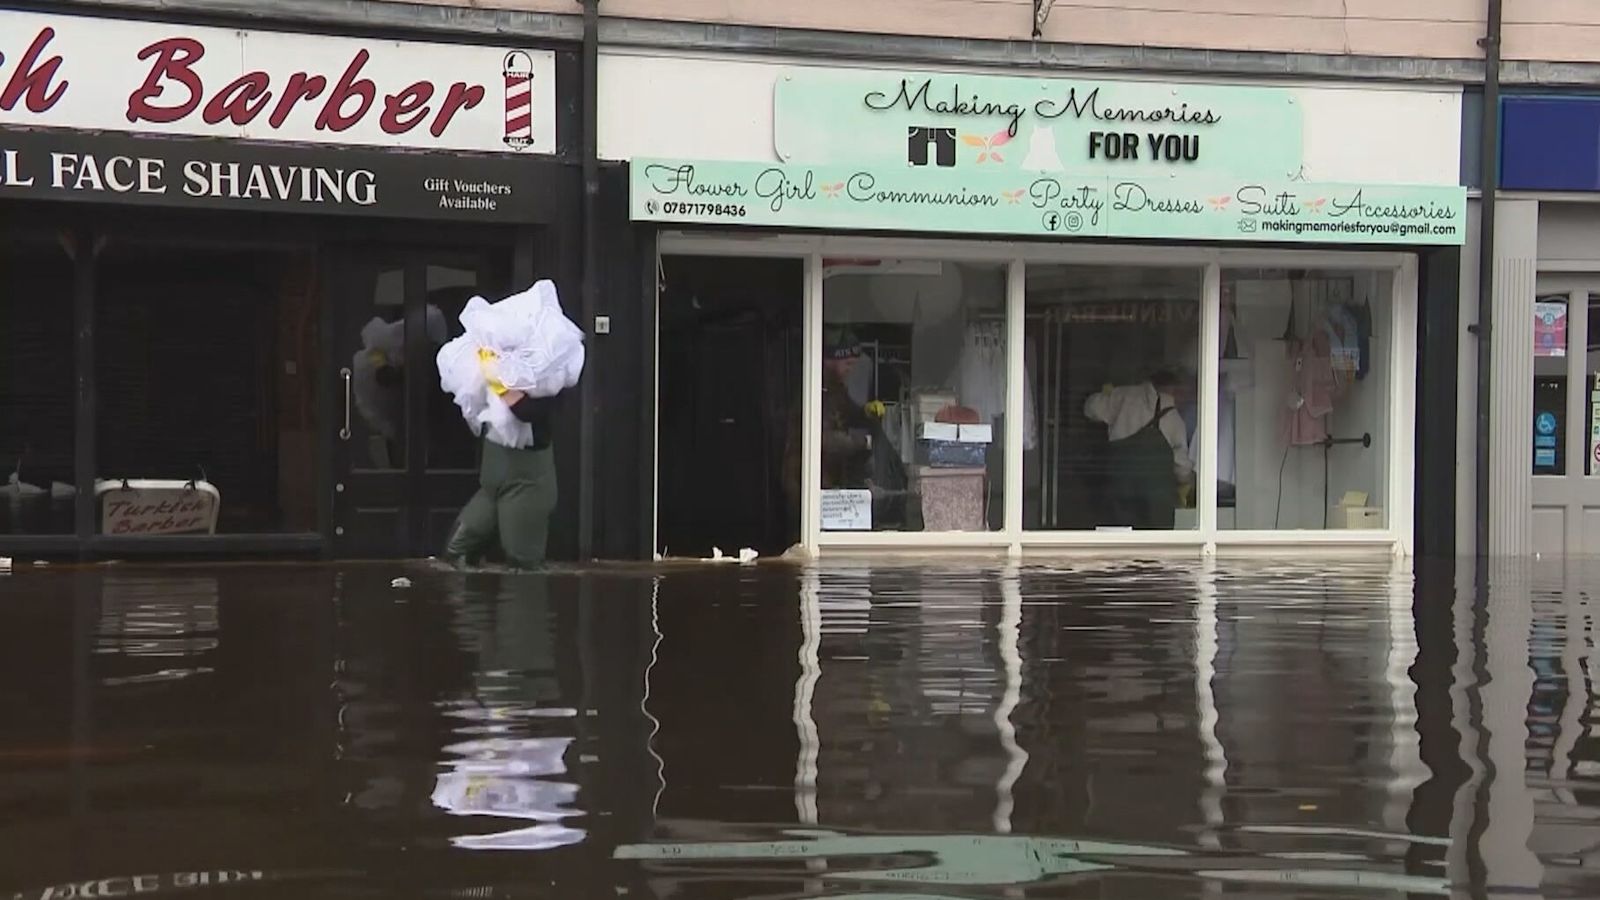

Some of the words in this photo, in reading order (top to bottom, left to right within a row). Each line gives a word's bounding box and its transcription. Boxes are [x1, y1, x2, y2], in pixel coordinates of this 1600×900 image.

[0, 27, 69, 114] h
[128, 37, 485, 138] Barber
[864, 79, 1026, 136] Making
[1034, 87, 1221, 125] Memories
[1089, 132, 1140, 160] FOR
[1147, 134, 1200, 162] YOU
[0, 150, 35, 187] L
[50, 152, 167, 194] FACE
[182, 161, 378, 205] SHAVING
[424, 178, 450, 193] Gift
[453, 180, 512, 196] Vouchers
[439, 194, 498, 211] Available
[645, 164, 748, 195] Flower
[755, 168, 816, 212] Girl
[846, 172, 999, 207] Communion
[1029, 178, 1104, 226] Party
[1113, 182, 1204, 214] Dresses
[1236, 185, 1300, 216] Suits
[1327, 188, 1456, 219] Accessories
[663, 201, 746, 217] 07871798436
[1261, 219, 1456, 237] makingmemoriesforyou@gmail.com
[107, 499, 205, 518] Turkish
[111, 516, 202, 534] Barber
